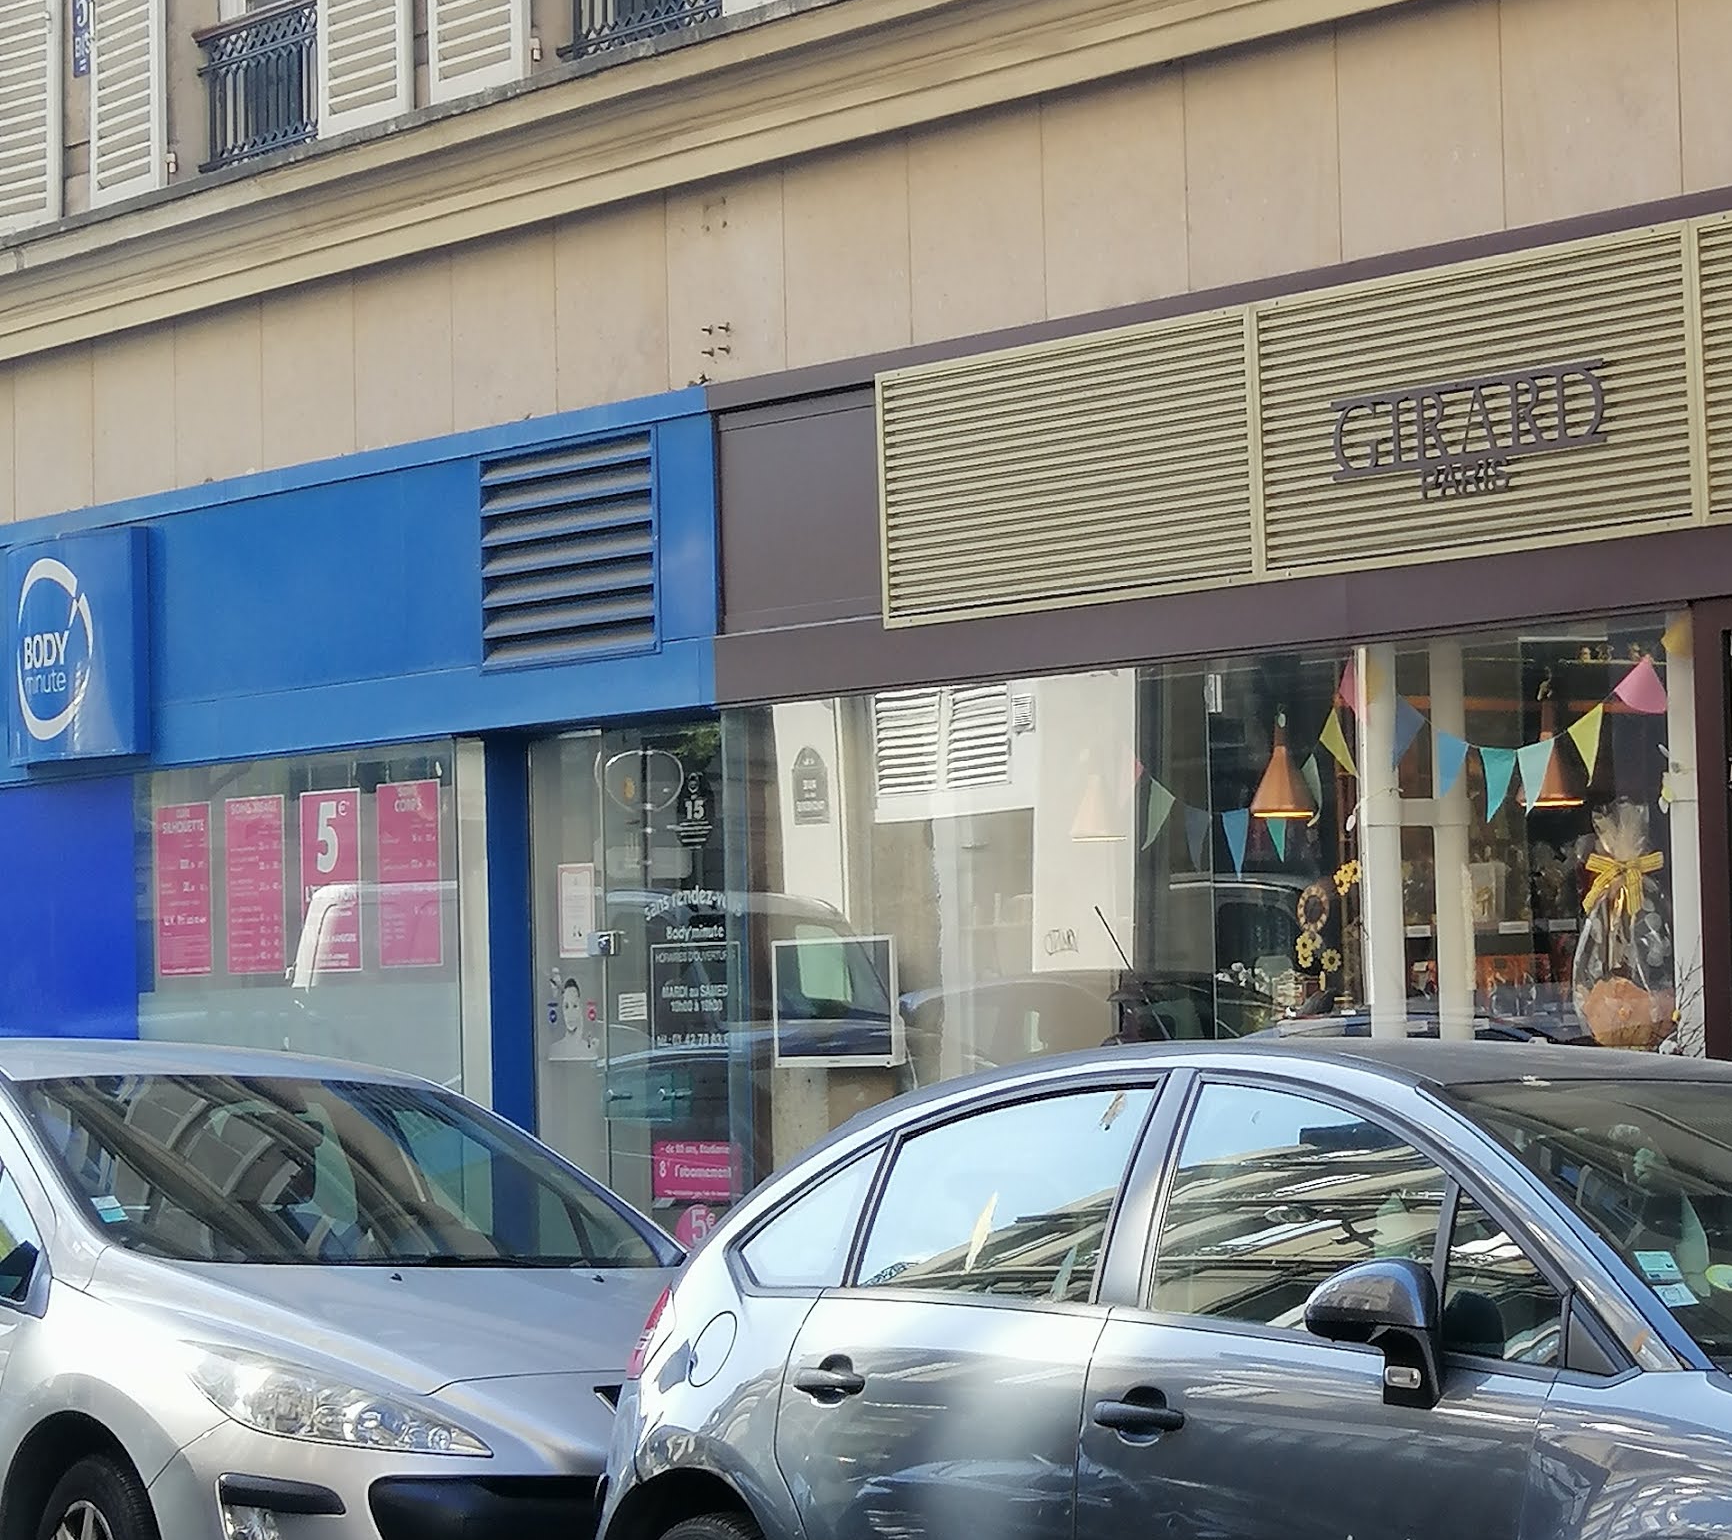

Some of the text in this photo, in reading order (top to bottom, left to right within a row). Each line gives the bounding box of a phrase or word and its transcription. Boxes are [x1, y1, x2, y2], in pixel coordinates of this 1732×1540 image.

[1331, 360, 1607, 479] GIRARD
[1421, 458, 1510, 501] PARIS
[23, 629, 70, 671] BODY
[24, 669, 67, 695] minute
[684, 799, 705, 820] 15
[161, 819, 205, 835] SILHOUETTE
[644, 884, 743, 922] sans rendez-vs
[661, 984, 688, 999] MARDI
[700, 983, 730, 998] SAMED
